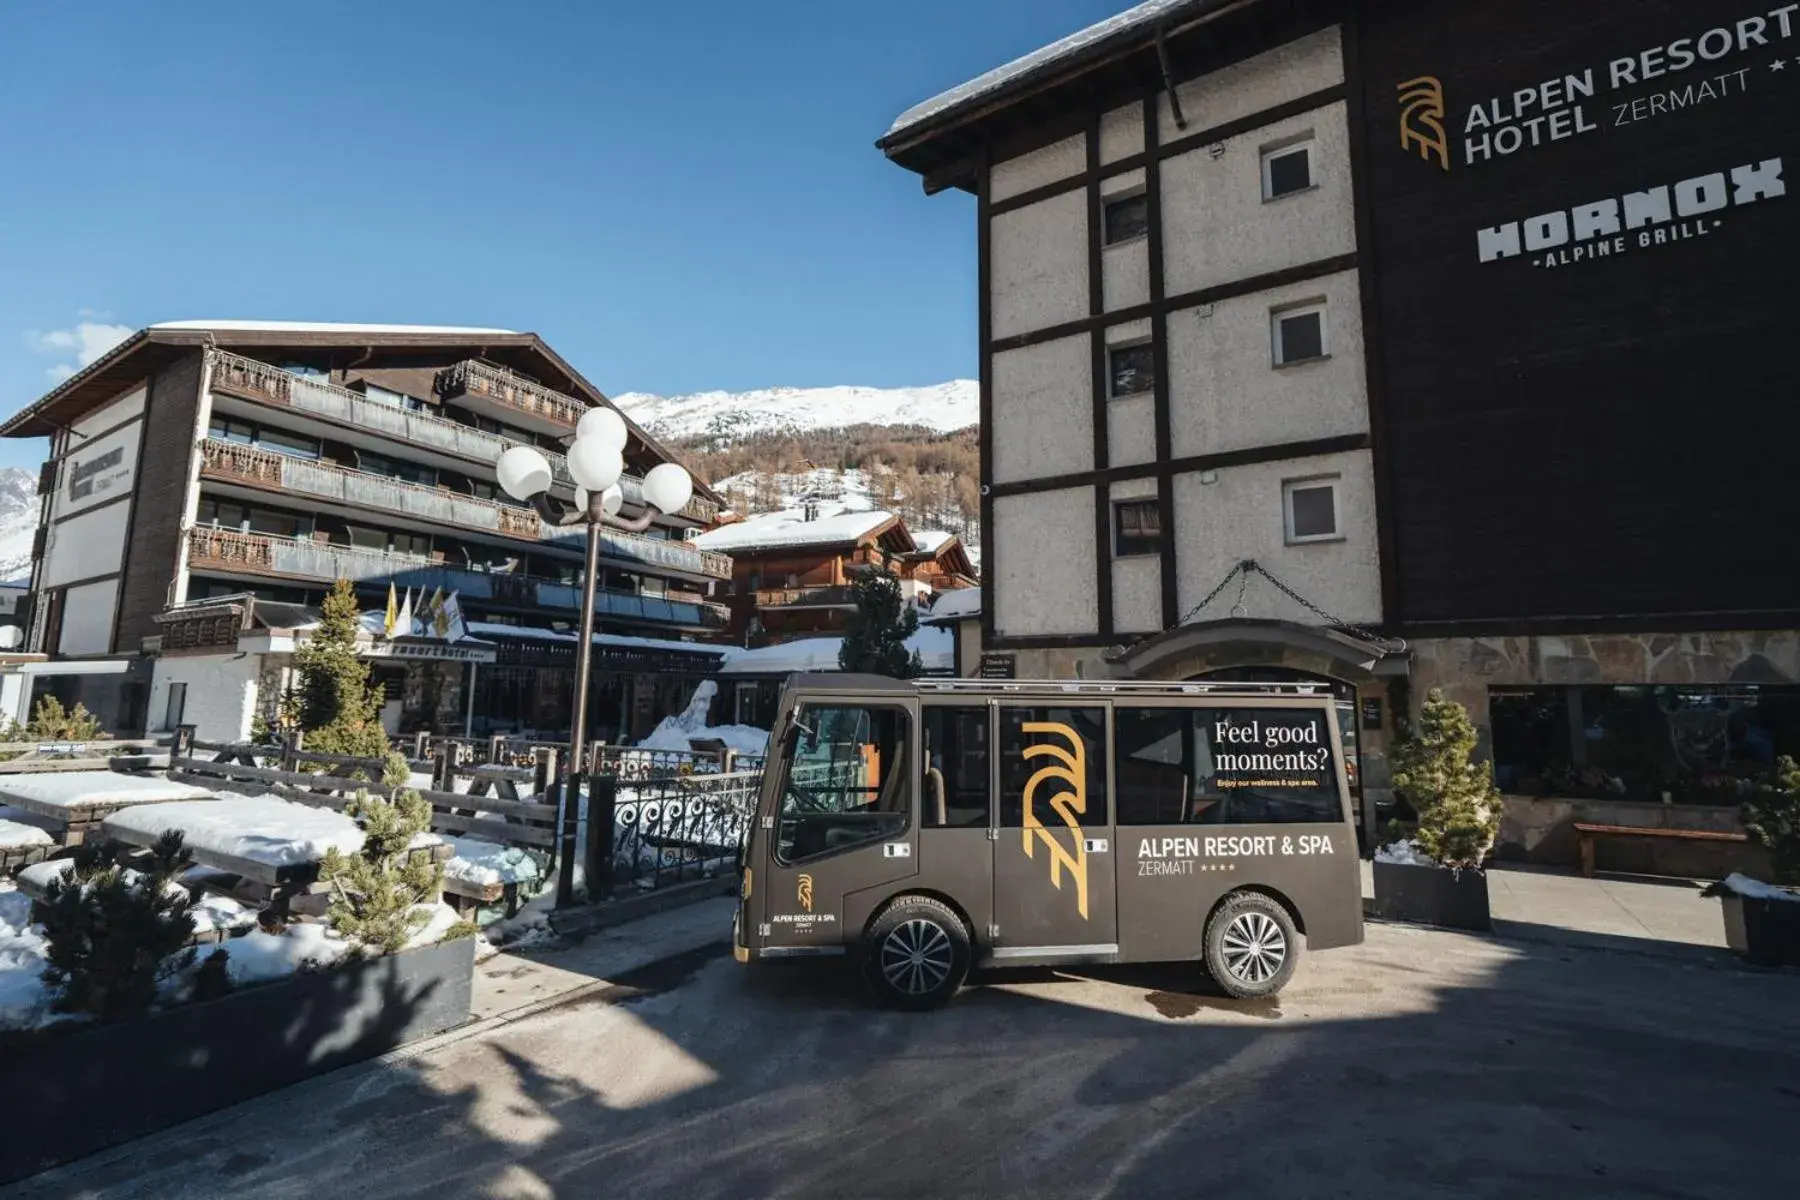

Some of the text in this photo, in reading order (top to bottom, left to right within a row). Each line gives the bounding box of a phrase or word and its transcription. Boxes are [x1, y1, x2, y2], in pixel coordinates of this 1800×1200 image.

[1465, 4, 1798, 133] ALPEN RESORT
[1465, 68, 1751, 165] HOTEL ZERMATT
[1477, 157, 1786, 263] HORNOX
[1215, 720, 1318, 747] Feel good
[1216, 747, 1328, 771] moments?
[1217, 778, 1237, 788] Enjoy
[1250, 779, 1280, 787] wellness
[1281, 779, 1287, 787] &
[1287, 780, 1300, 788] spa
[1138, 835, 1334, 858] ALPEN RESORT & SPA
[1138, 859, 1194, 876] ZERMATT
[773, 914, 793, 922] ALPEN
[793, 914, 817, 922] RESORT
